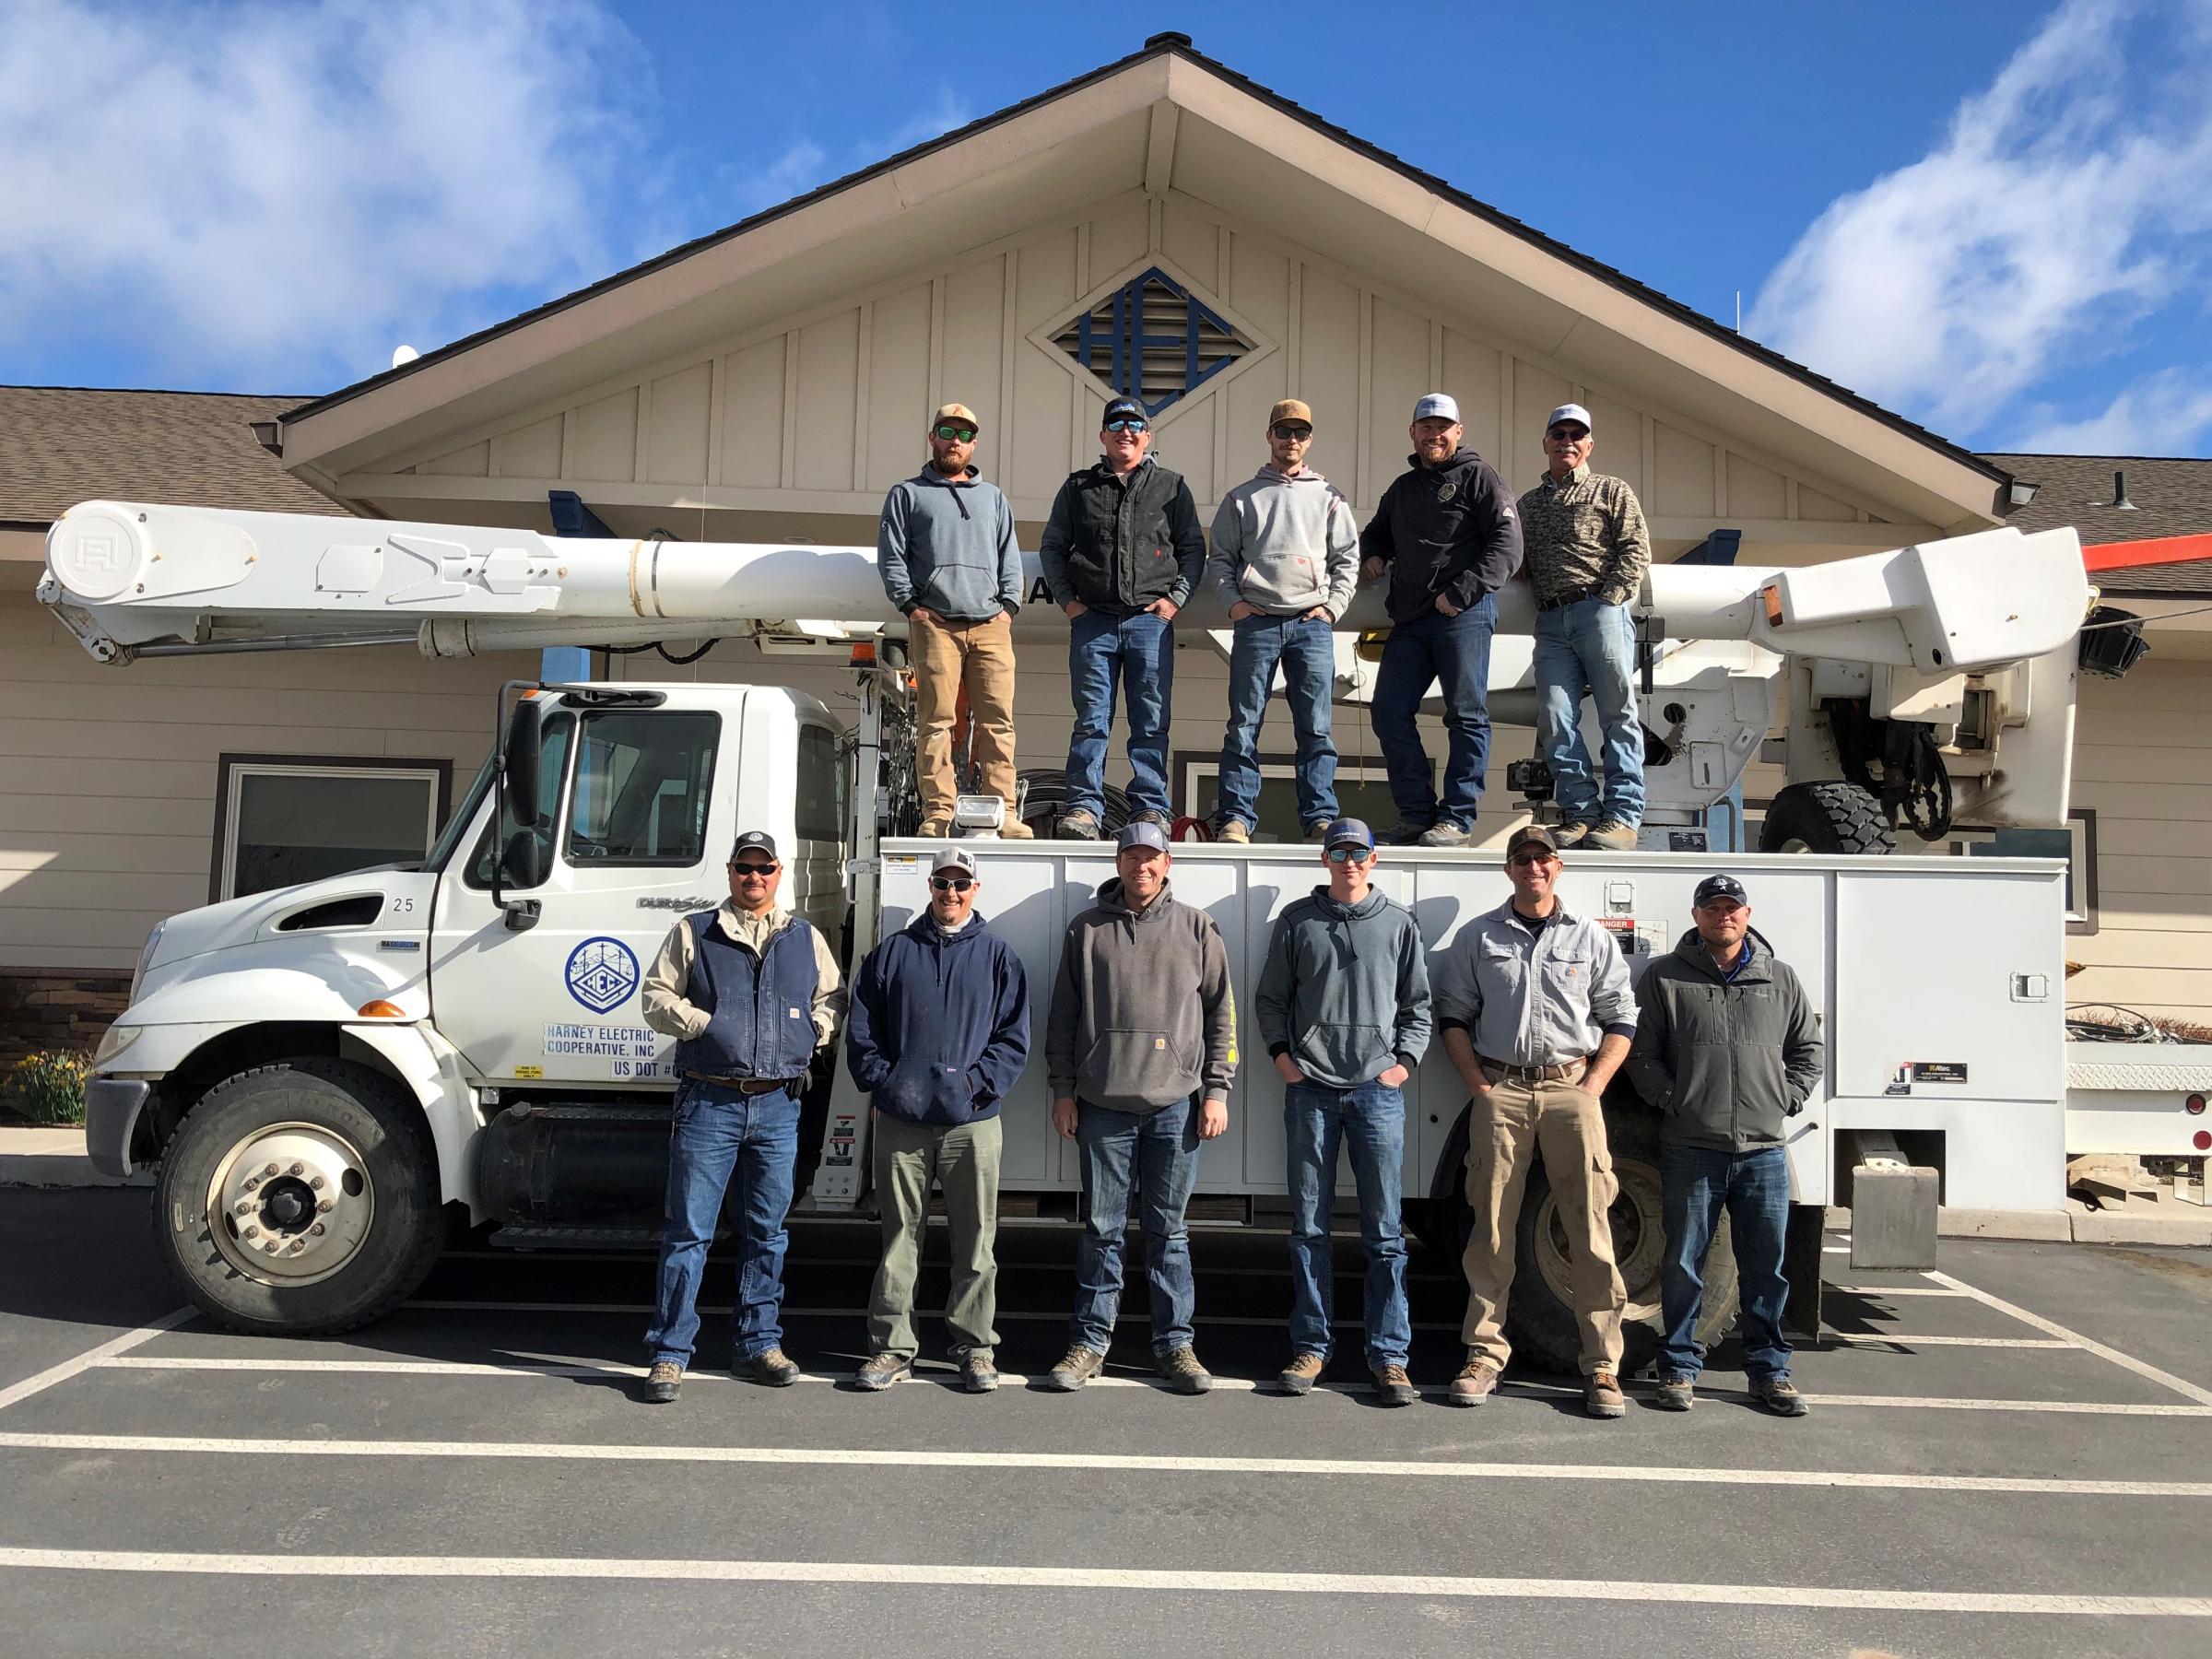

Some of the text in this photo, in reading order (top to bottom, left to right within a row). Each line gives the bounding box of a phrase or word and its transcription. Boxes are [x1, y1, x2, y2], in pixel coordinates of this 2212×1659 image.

[394, 898, 414, 912] 25
[547, 1025, 654, 1041] HARNEY ELECTRIC
[635, 1044, 654, 1057] INC
[614, 1061, 629, 1076] US
[636, 1062, 658, 1077] DOT
